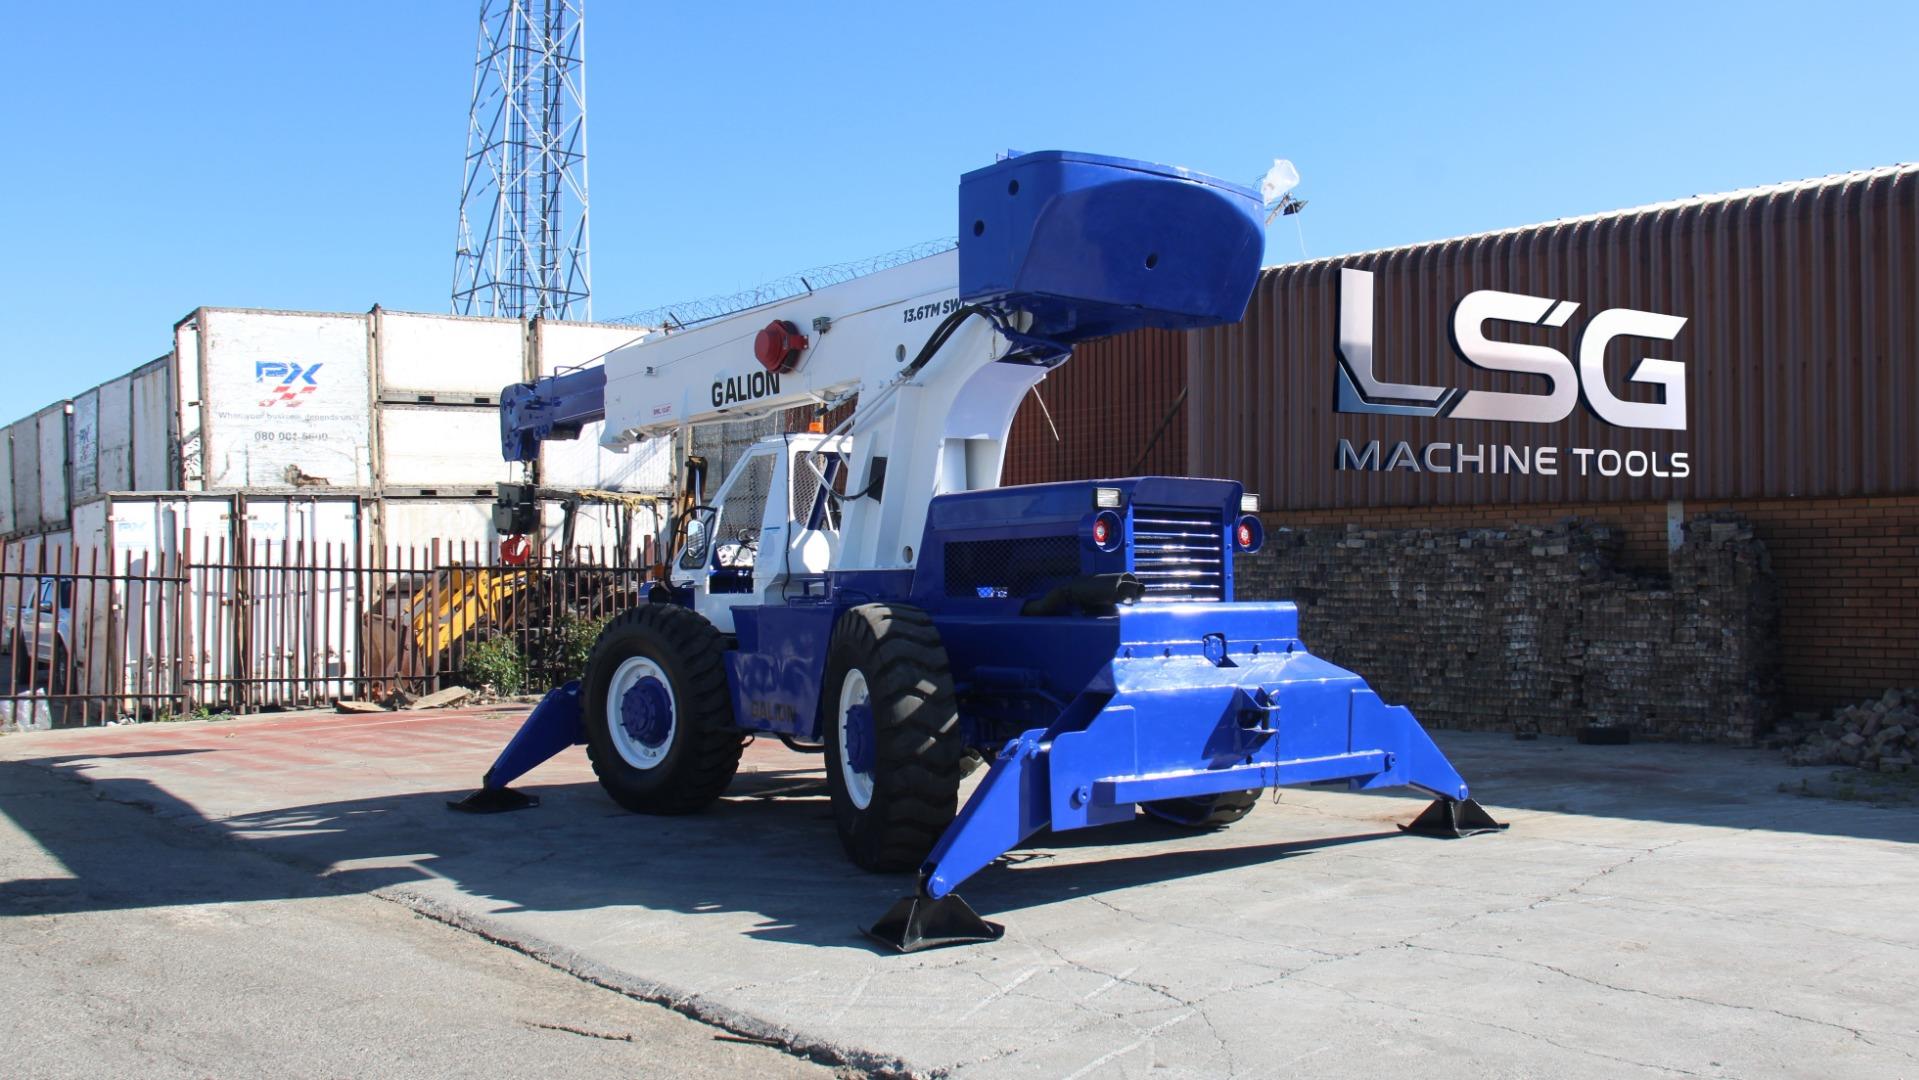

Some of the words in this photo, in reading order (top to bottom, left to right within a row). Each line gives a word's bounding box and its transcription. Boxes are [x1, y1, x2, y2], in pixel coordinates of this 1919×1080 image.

[903, 302, 941, 323] 13.6TM
[1338, 268, 1688, 430] LSG
[255, 361, 324, 384] PX
[712, 370, 780, 407] GALION
[255, 431, 275, 441] 080
[1338, 438, 1558, 475] MACHINE
[1572, 447, 1690, 478] TOOLS
